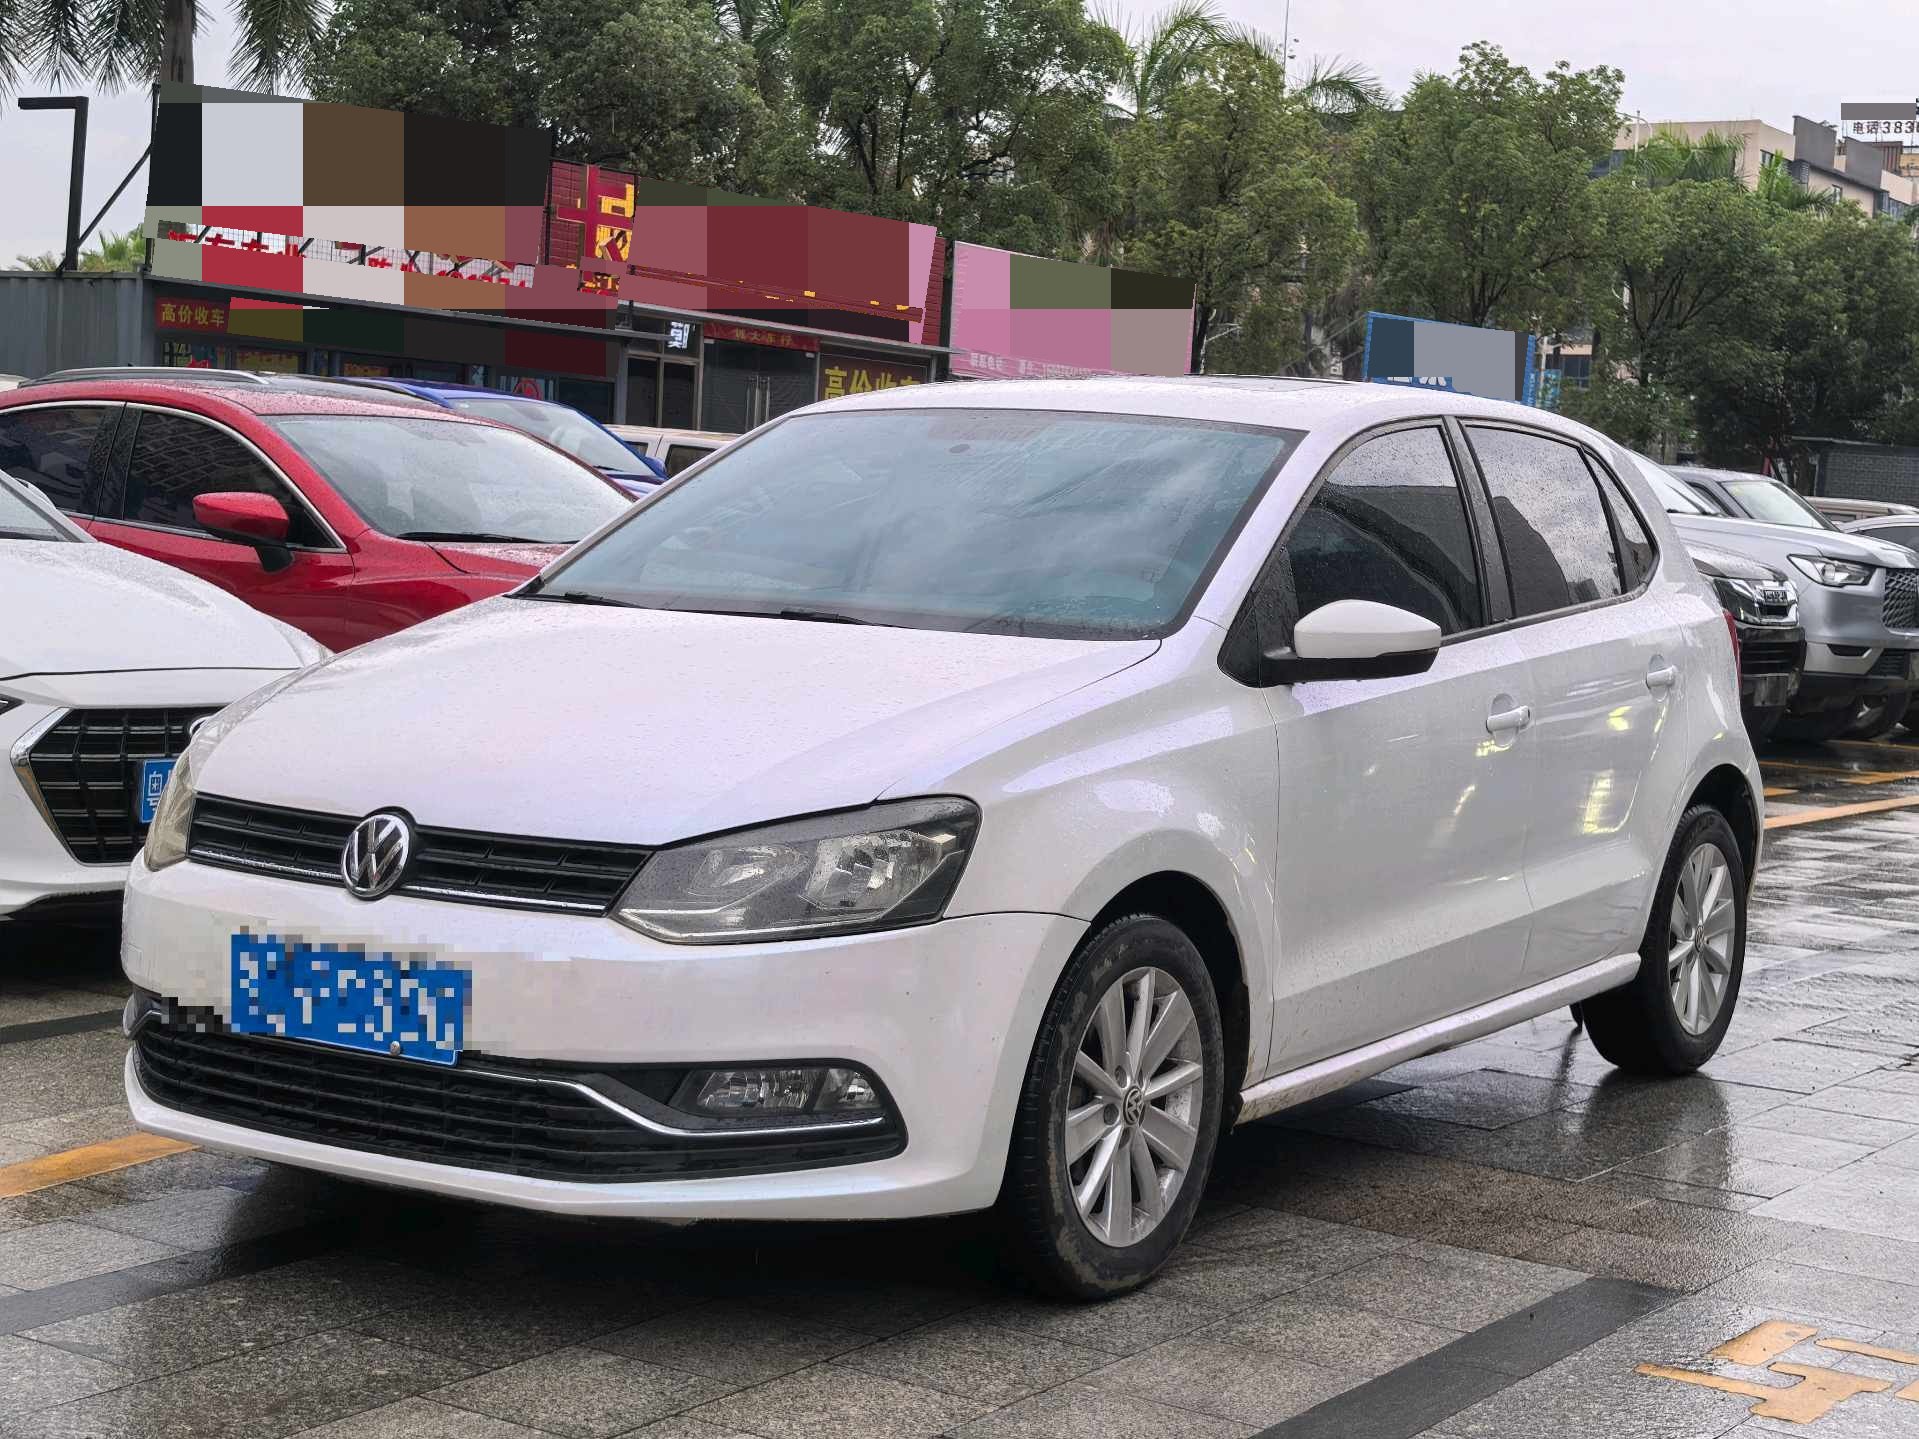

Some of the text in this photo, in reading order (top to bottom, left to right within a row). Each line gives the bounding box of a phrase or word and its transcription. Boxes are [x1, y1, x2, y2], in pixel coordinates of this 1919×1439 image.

[161, 303, 225, 327] 高价收车
[825, 366, 920, 400] 高价
